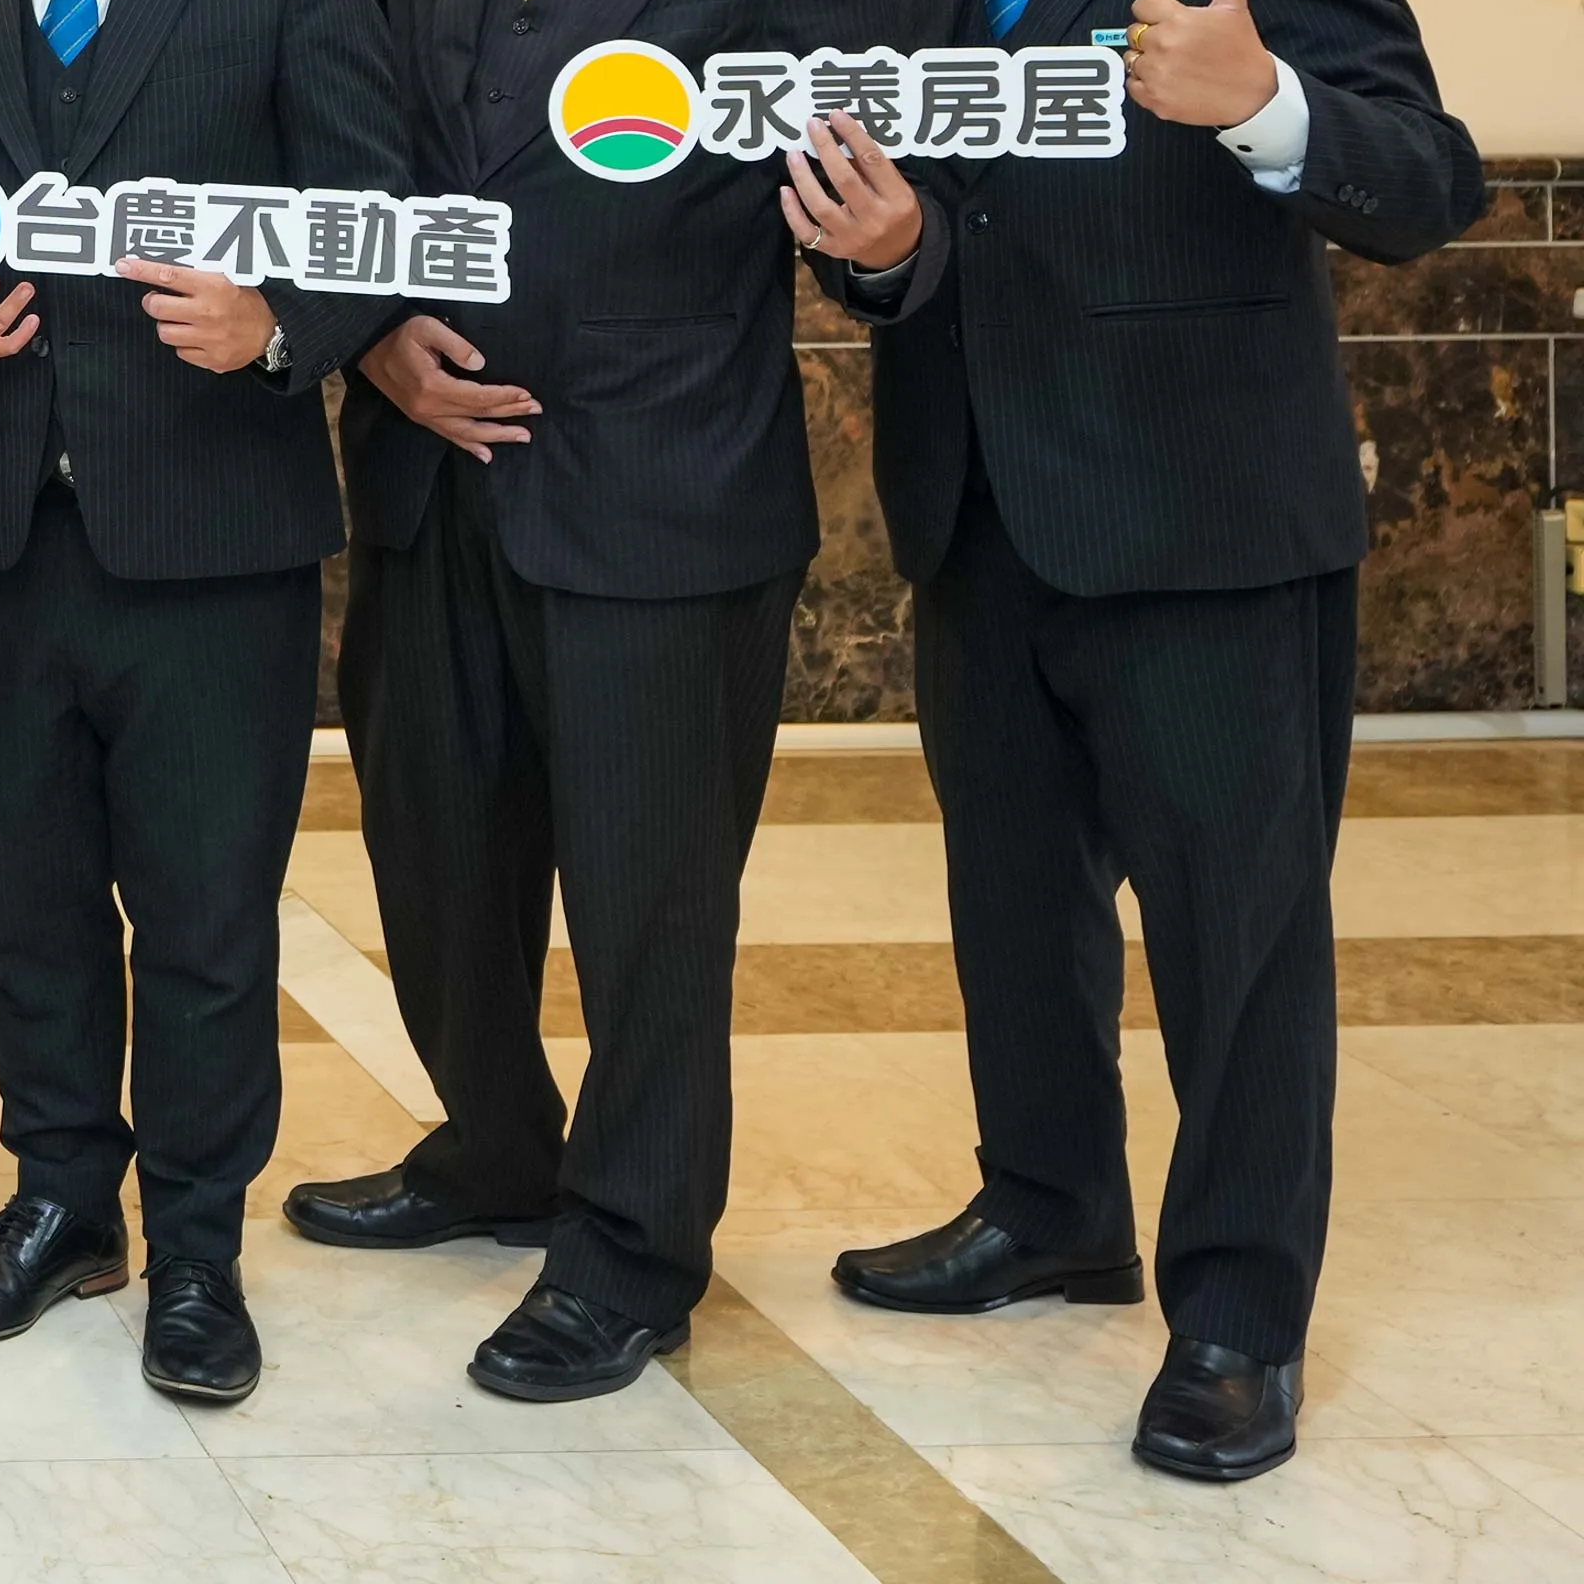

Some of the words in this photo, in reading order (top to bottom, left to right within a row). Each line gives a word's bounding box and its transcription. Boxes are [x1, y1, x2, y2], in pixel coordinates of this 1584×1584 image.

[711, 59, 1112, 149] 永義房屋
[15, 183, 502, 293] 台慶不動產
